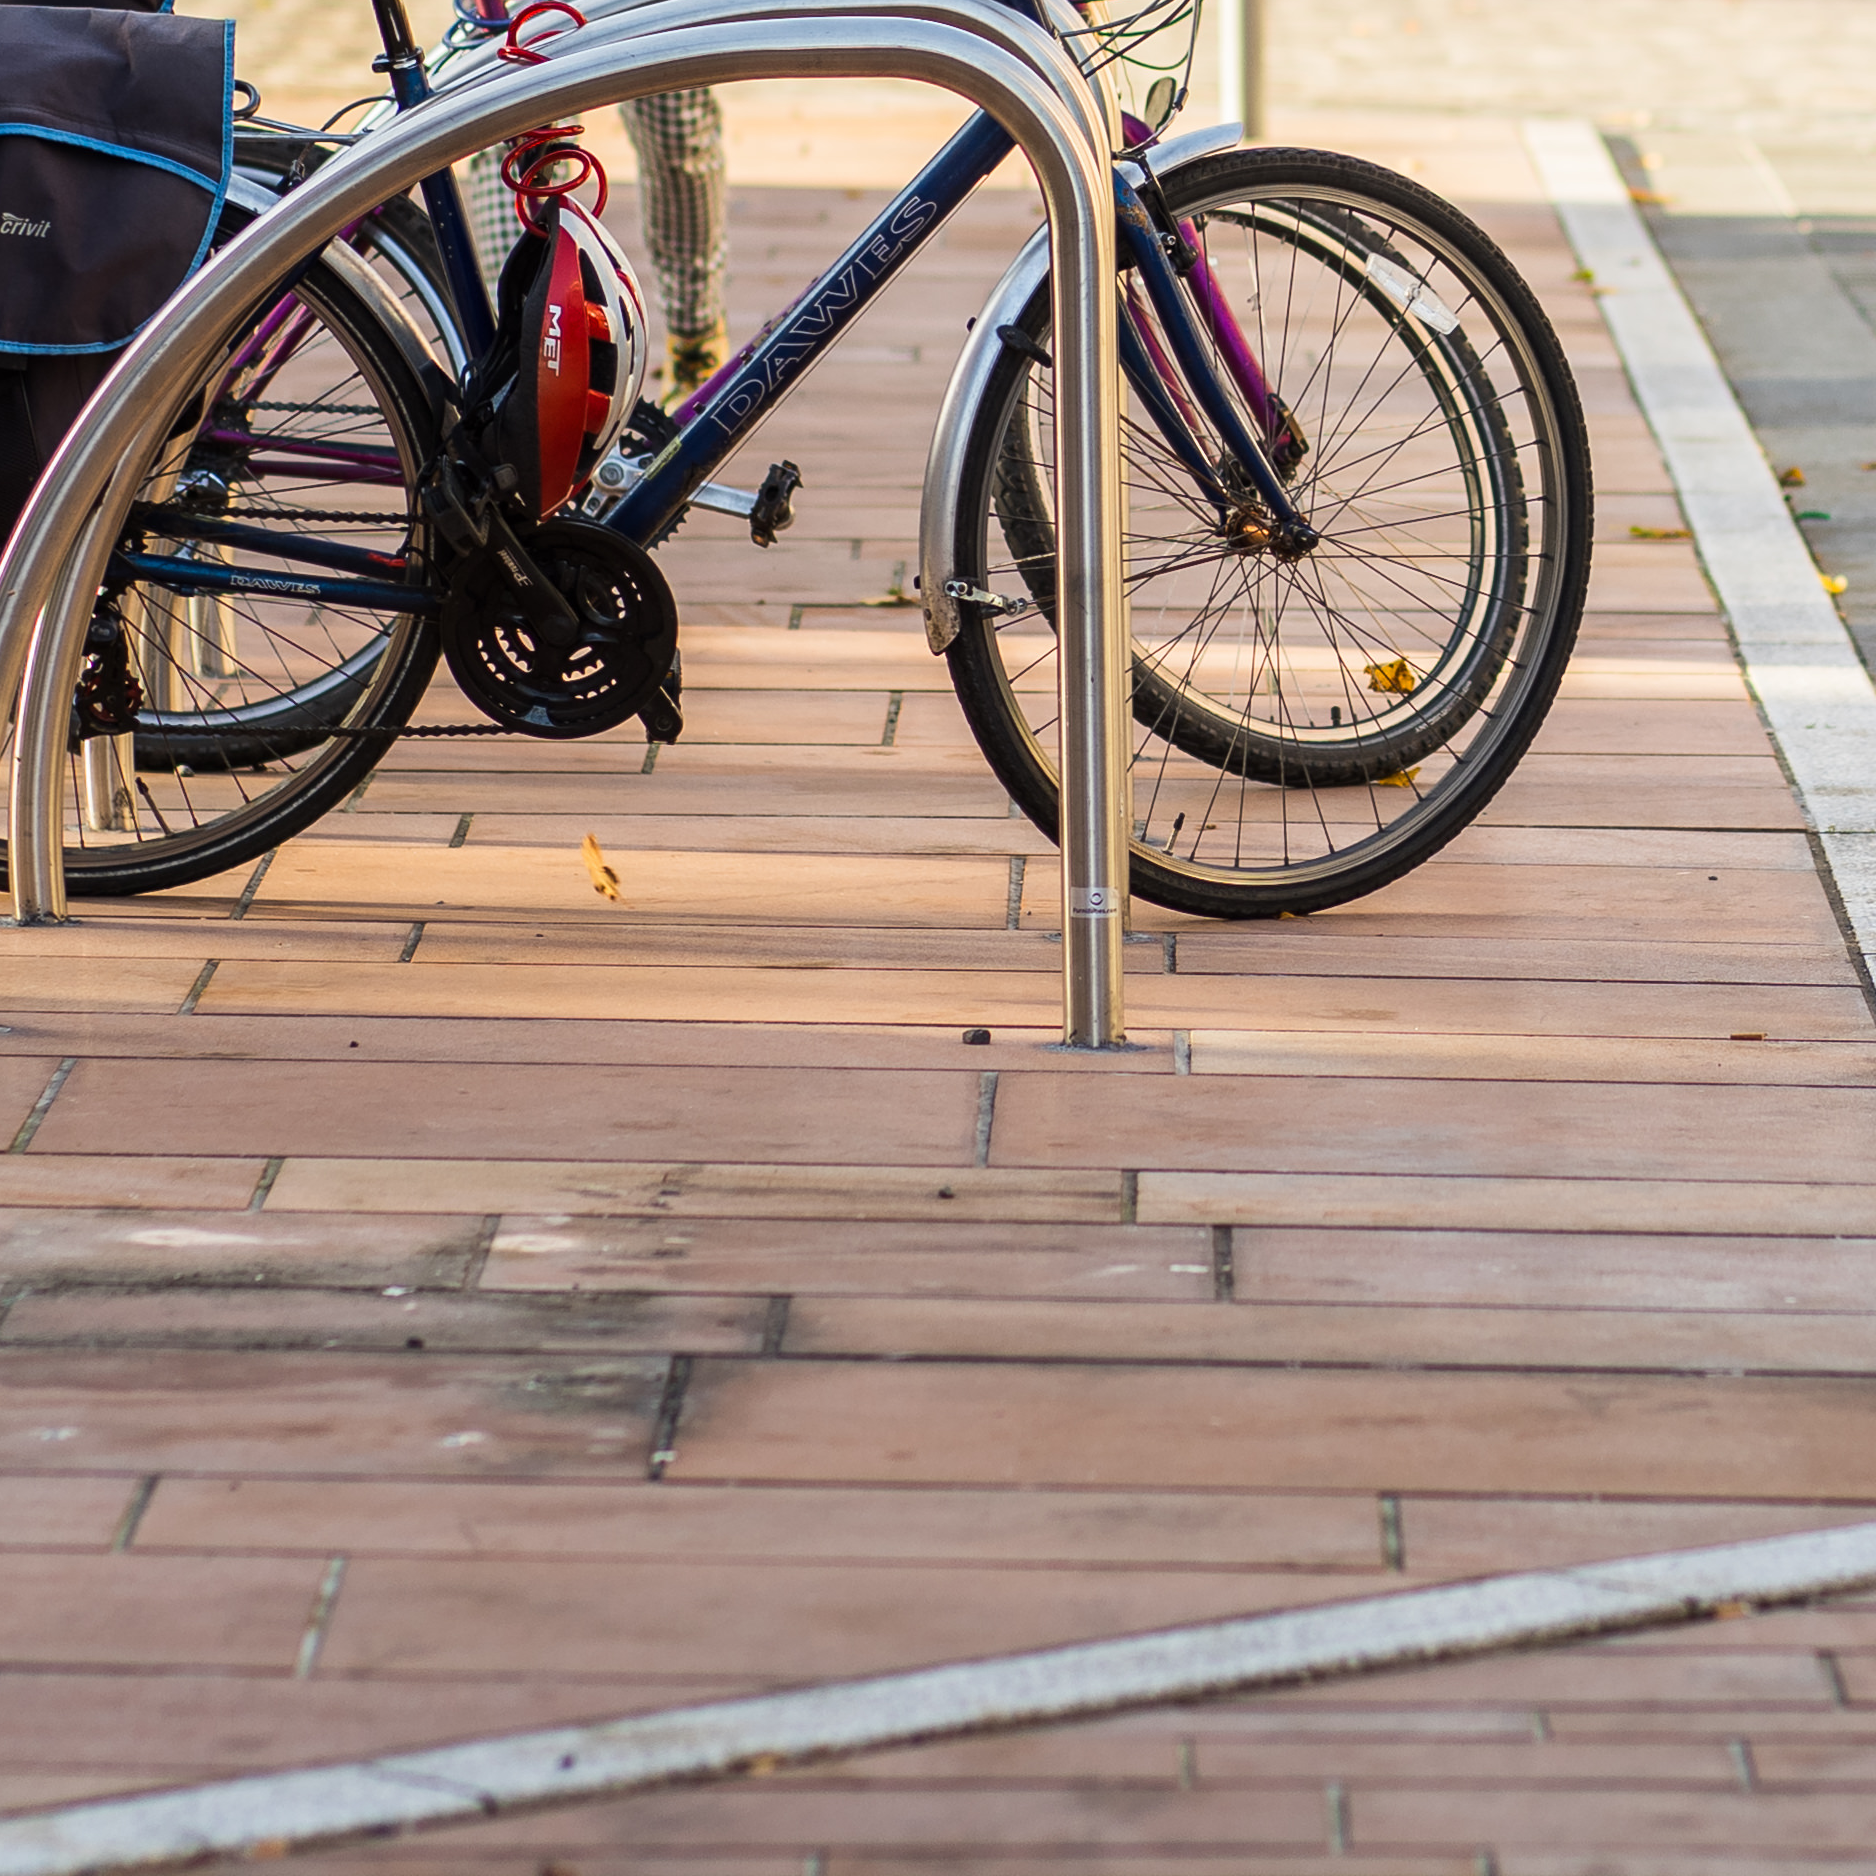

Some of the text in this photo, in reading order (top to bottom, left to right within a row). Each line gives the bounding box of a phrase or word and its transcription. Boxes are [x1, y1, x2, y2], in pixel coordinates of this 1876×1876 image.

[0, 214, 51, 238] crivit
[710, 196, 937, 436] DAWES
[544, 304, 561, 377] MET
[230, 575, 321, 595] DAWES
